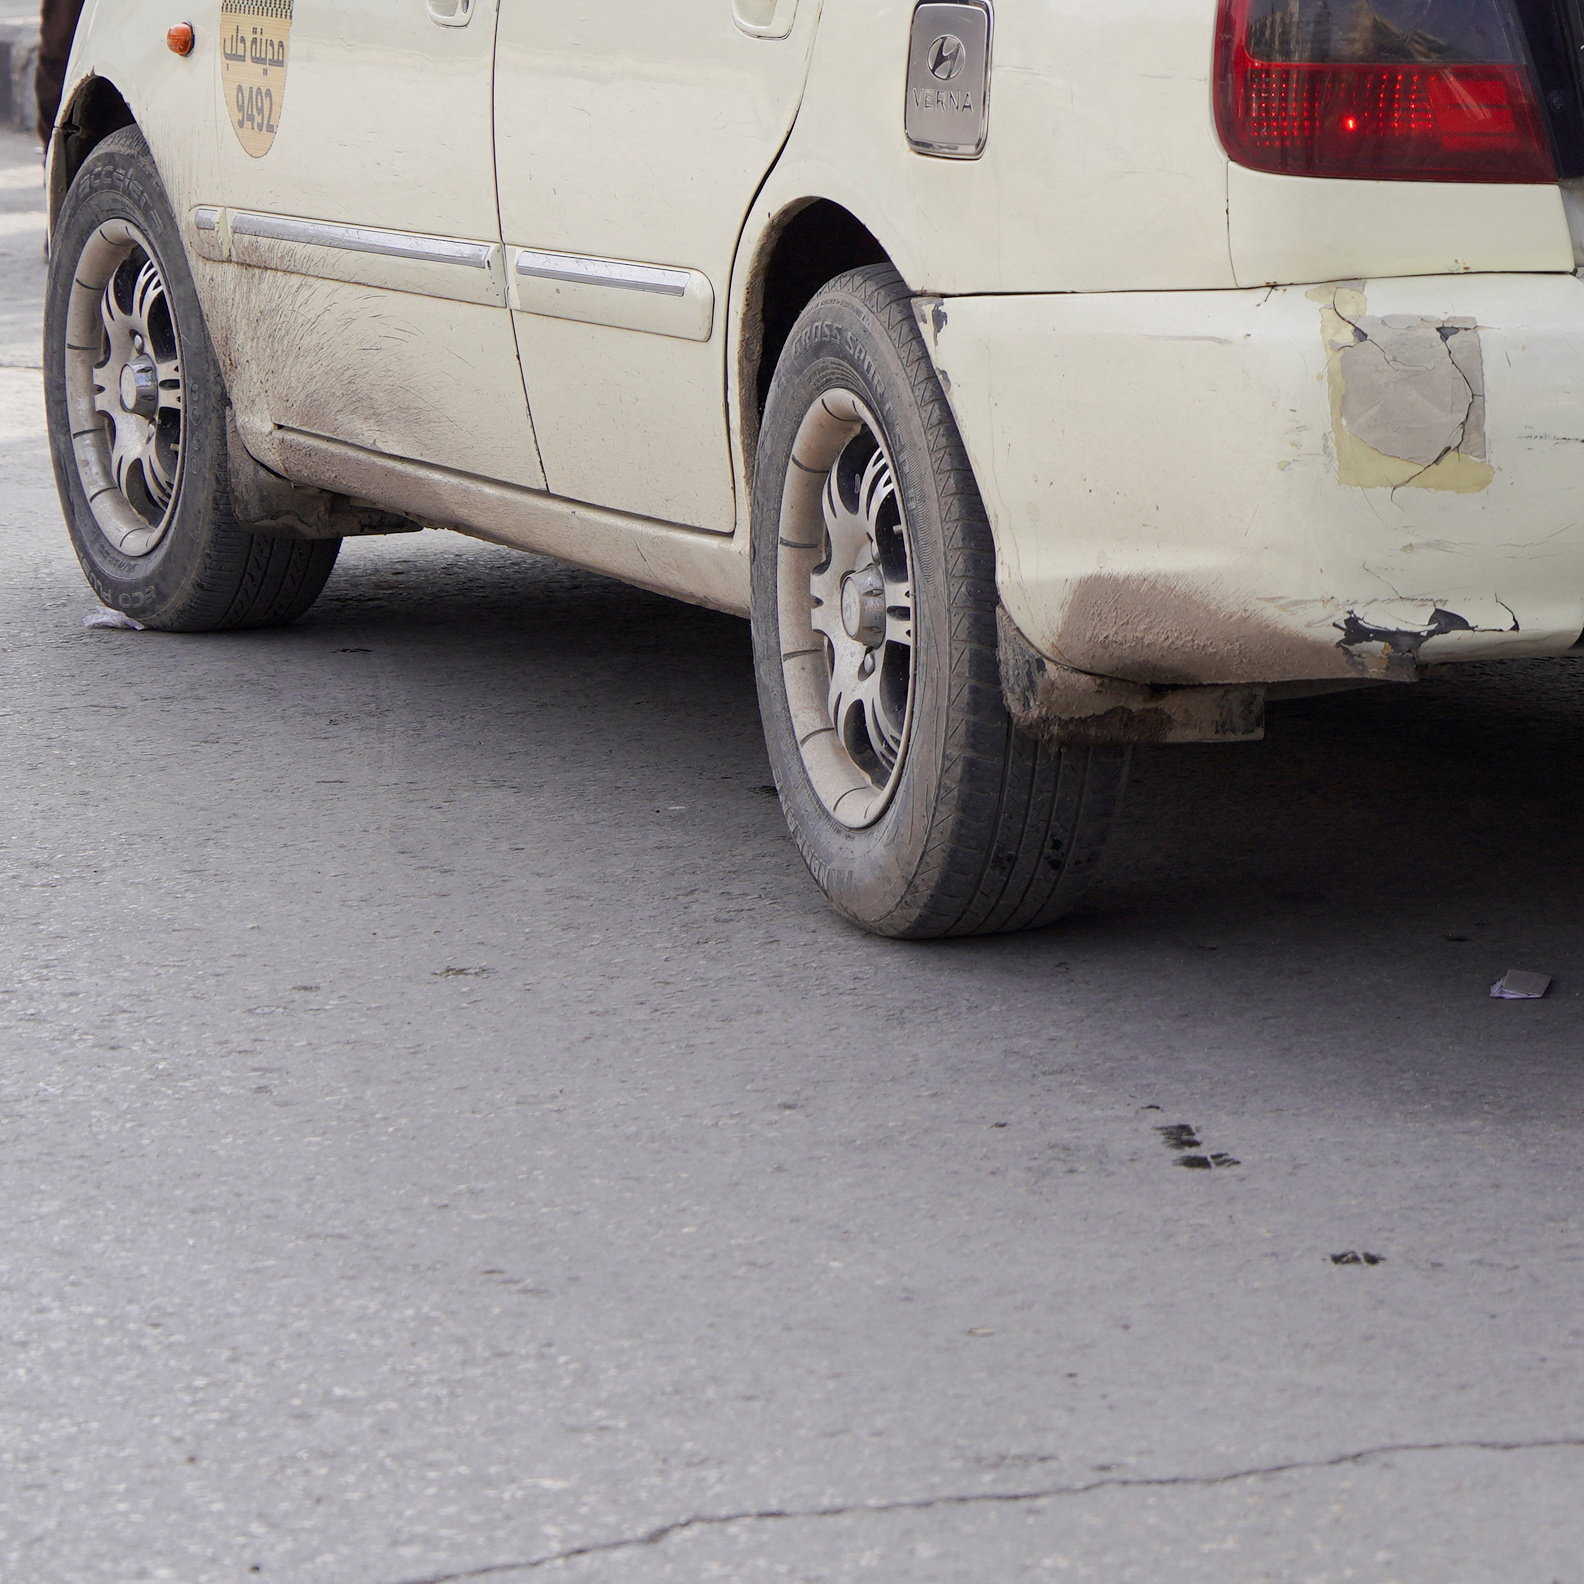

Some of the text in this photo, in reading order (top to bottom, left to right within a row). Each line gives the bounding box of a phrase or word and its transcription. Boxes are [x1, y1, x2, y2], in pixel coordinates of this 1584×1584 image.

[223, 24, 285, 76] مدينة حلب
[235, 83, 275, 134] 9492
[912, 87, 974, 113] VERNA
[118, 584, 157, 610] ECO
